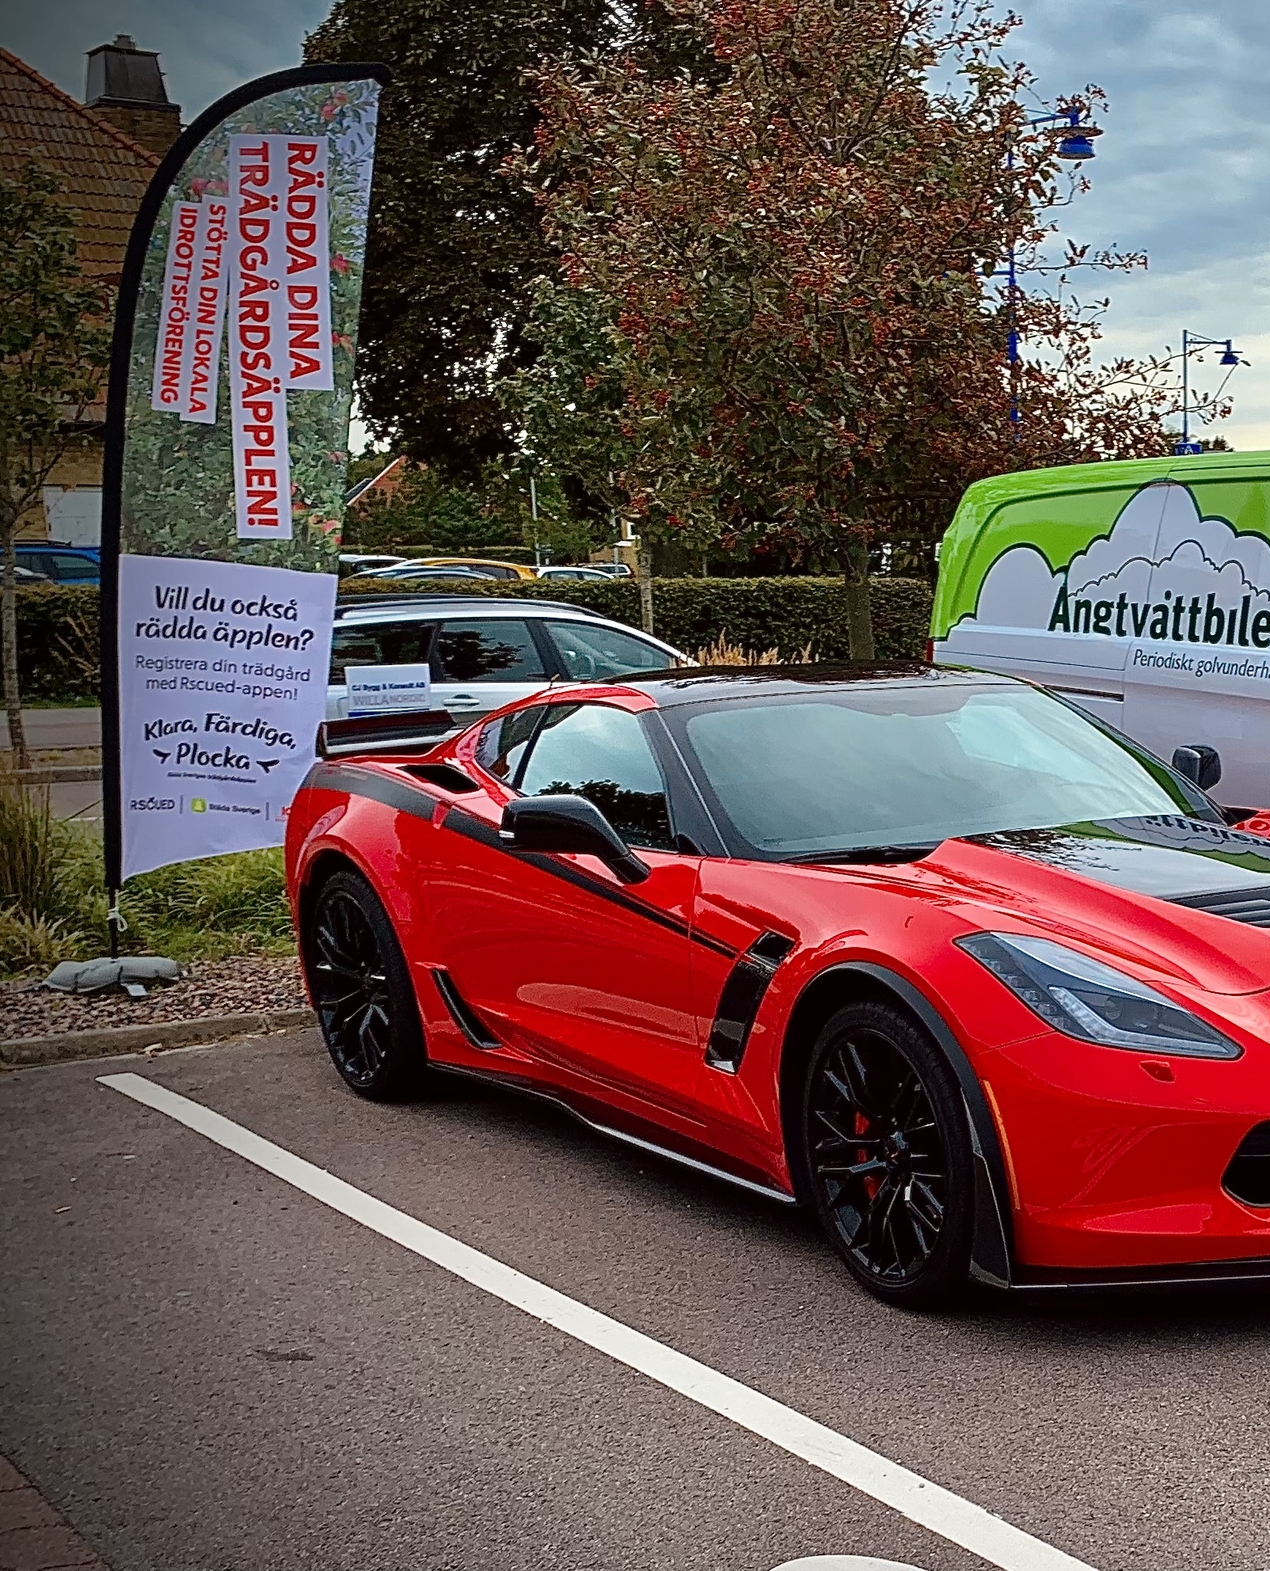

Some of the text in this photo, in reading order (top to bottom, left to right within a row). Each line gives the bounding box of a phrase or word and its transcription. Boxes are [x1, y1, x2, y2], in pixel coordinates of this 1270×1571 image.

[286, 142, 324, 380] RÄDDA DINA
[160, 206, 197, 404] IDROTTSFÖRENING
[188, 203, 228, 414] STÖTTA DIN LOKALA
[238, 140, 280, 529] TRÄDGÅRDSÄPPLEN!
[155, 585, 298, 622] Vill du också
[135, 615, 315, 651] rädda äpplen?
[135, 655, 311, 682] Registrera din trädgård
[1133, 649, 1194, 672] Periodiskt
[146, 676, 298, 701] med Rscued-appen!
[144, 712, 296, 749] Klara, Färdiga,
[176, 742, 251, 770] Plocka
